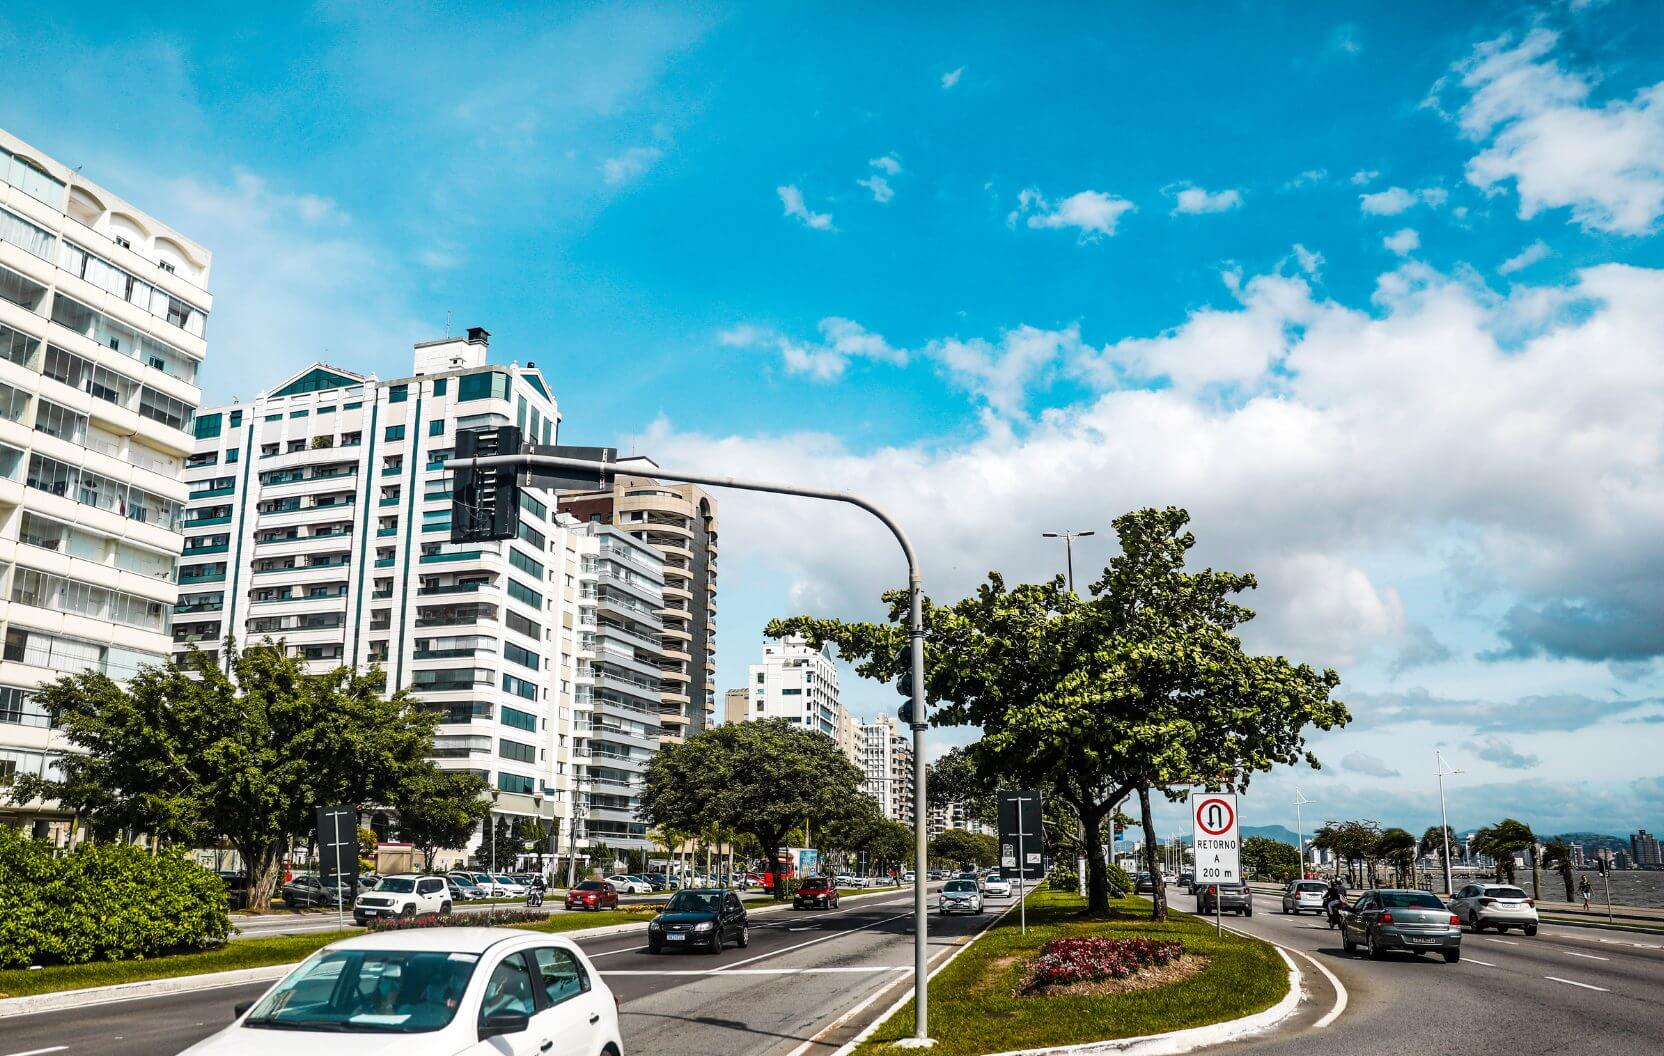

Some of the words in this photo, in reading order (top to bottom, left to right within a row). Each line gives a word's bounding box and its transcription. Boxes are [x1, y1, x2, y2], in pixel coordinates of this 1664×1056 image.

[1197, 840, 1236, 850] RETORNO
[1214, 854, 1220, 863] A
[1203, 868, 1220, 878] 200
